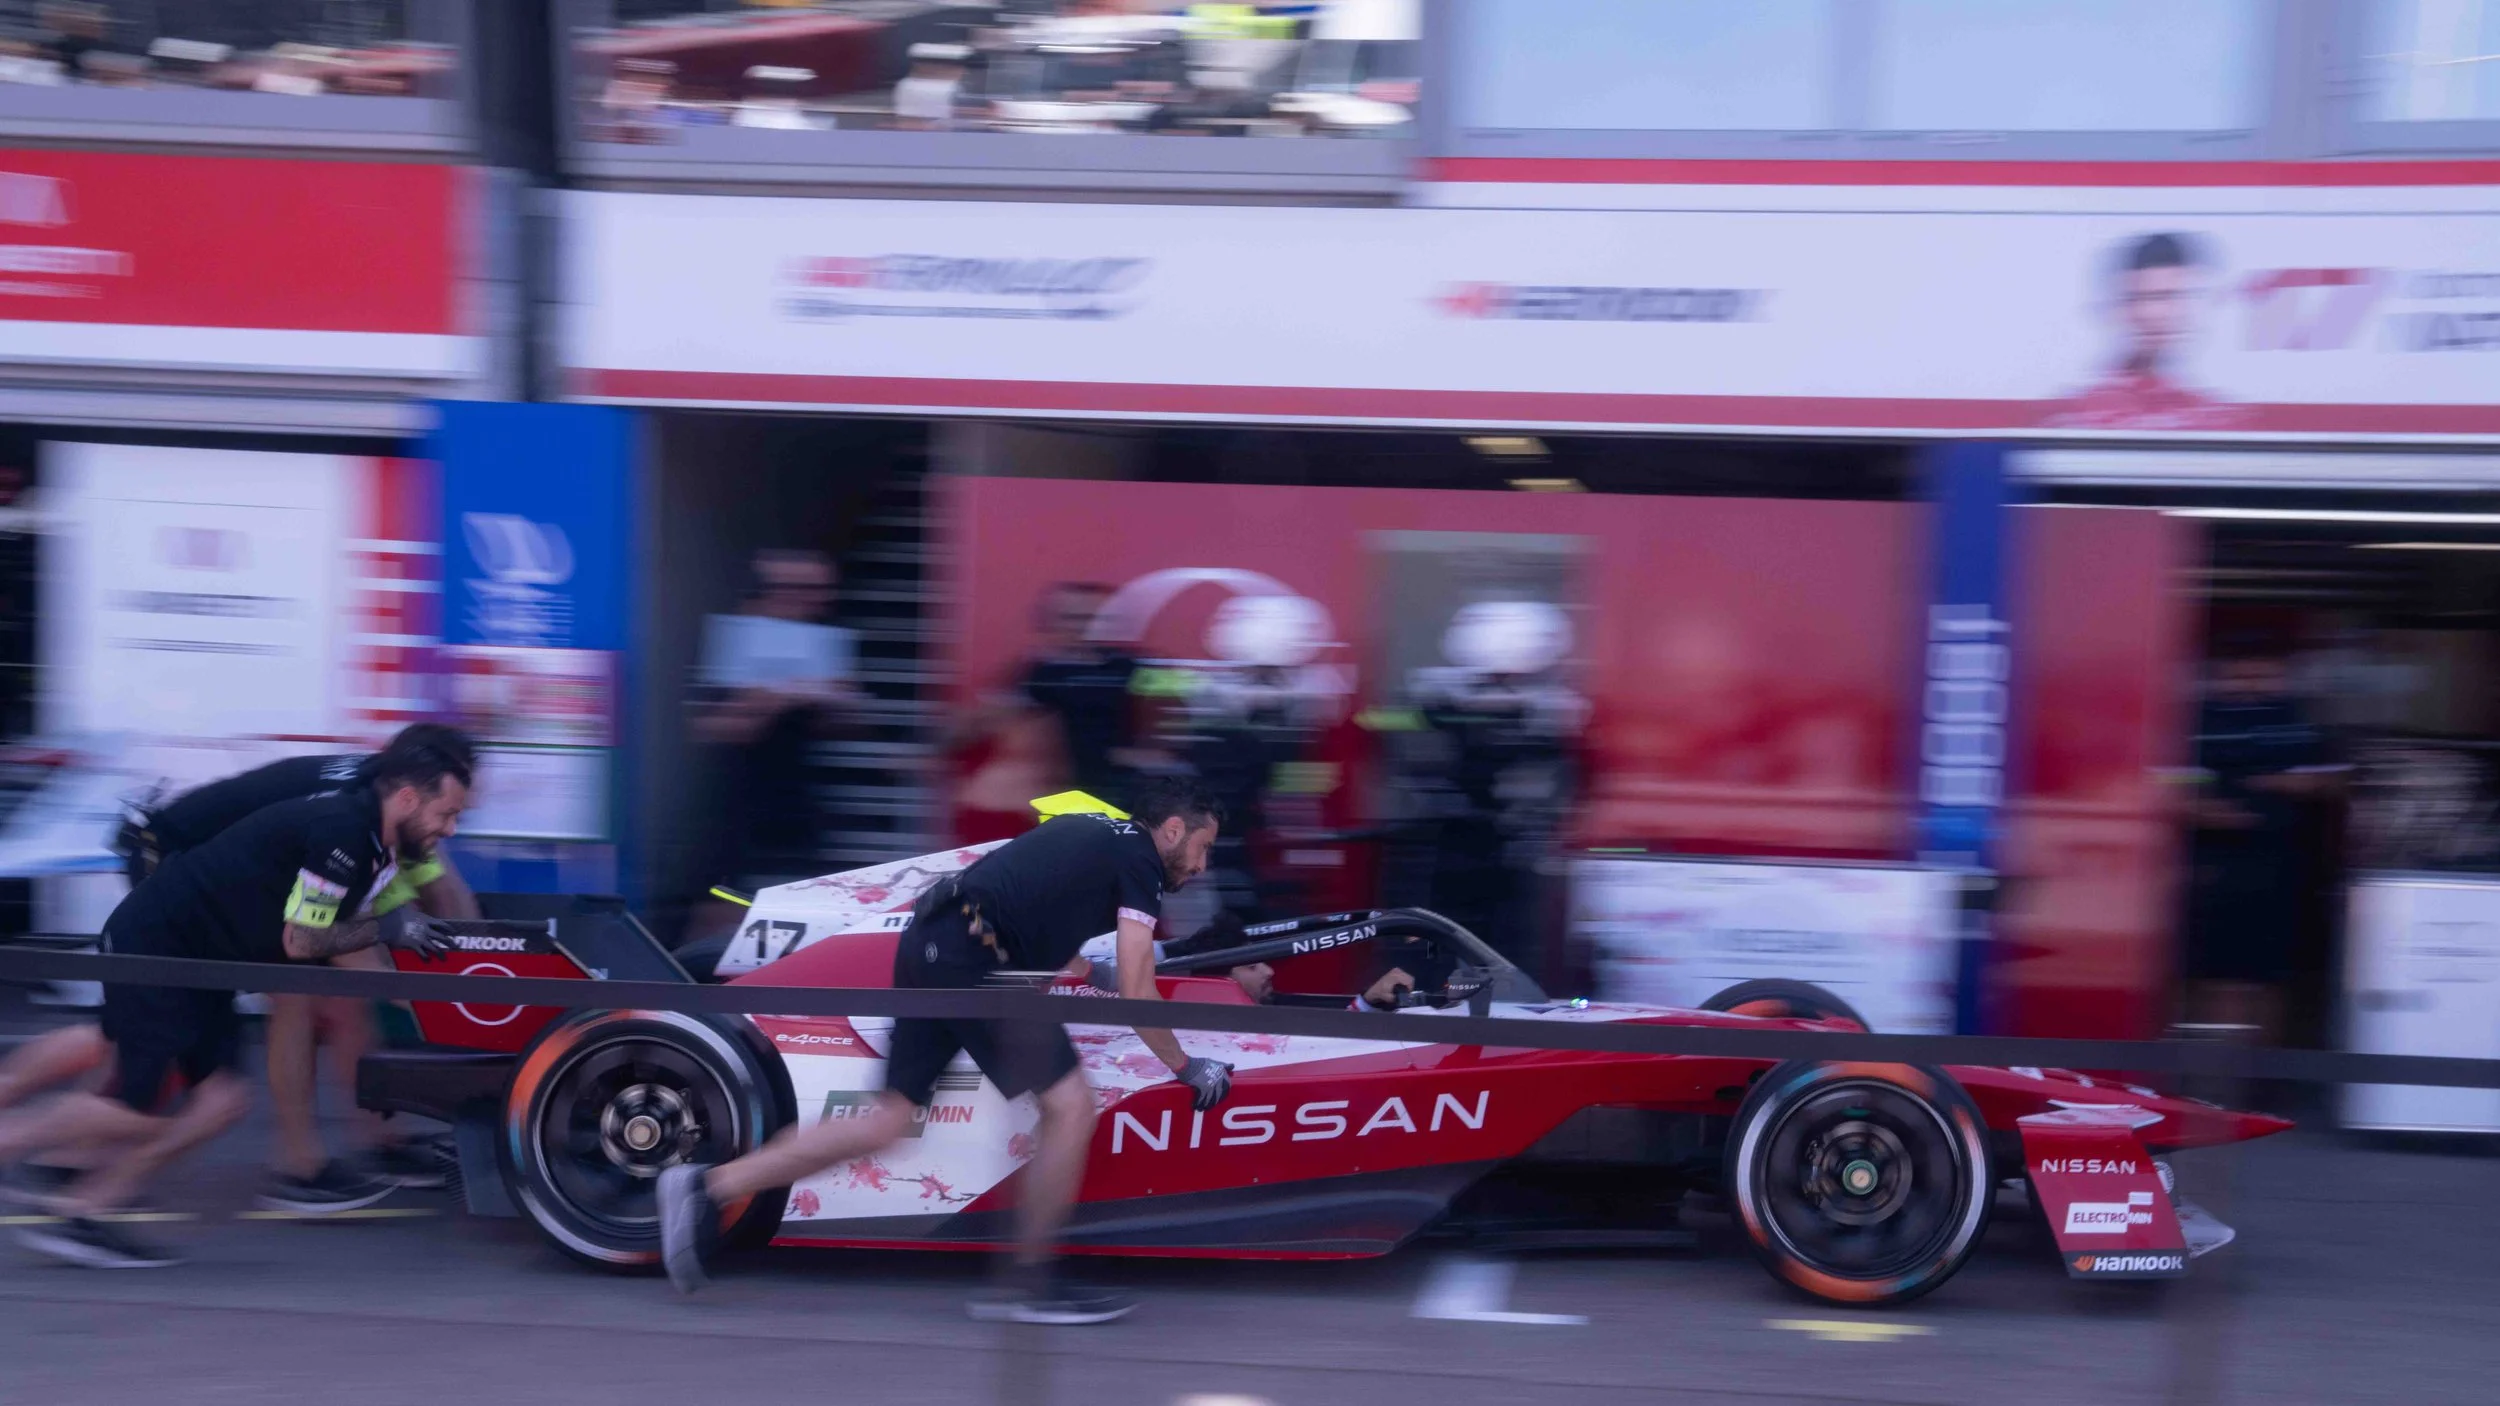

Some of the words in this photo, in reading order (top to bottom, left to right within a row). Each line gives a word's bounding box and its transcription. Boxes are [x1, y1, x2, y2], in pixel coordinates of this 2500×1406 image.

[744, 919, 807, 960] 17
[1292, 924, 1377, 954] NISSAN
[1048, 985, 1072, 996] ABB
[1448, 983, 1480, 991] NISSAN
[1111, 1089, 1491, 1155] NISSAN
[2041, 1158, 2137, 1175] NISSAN
